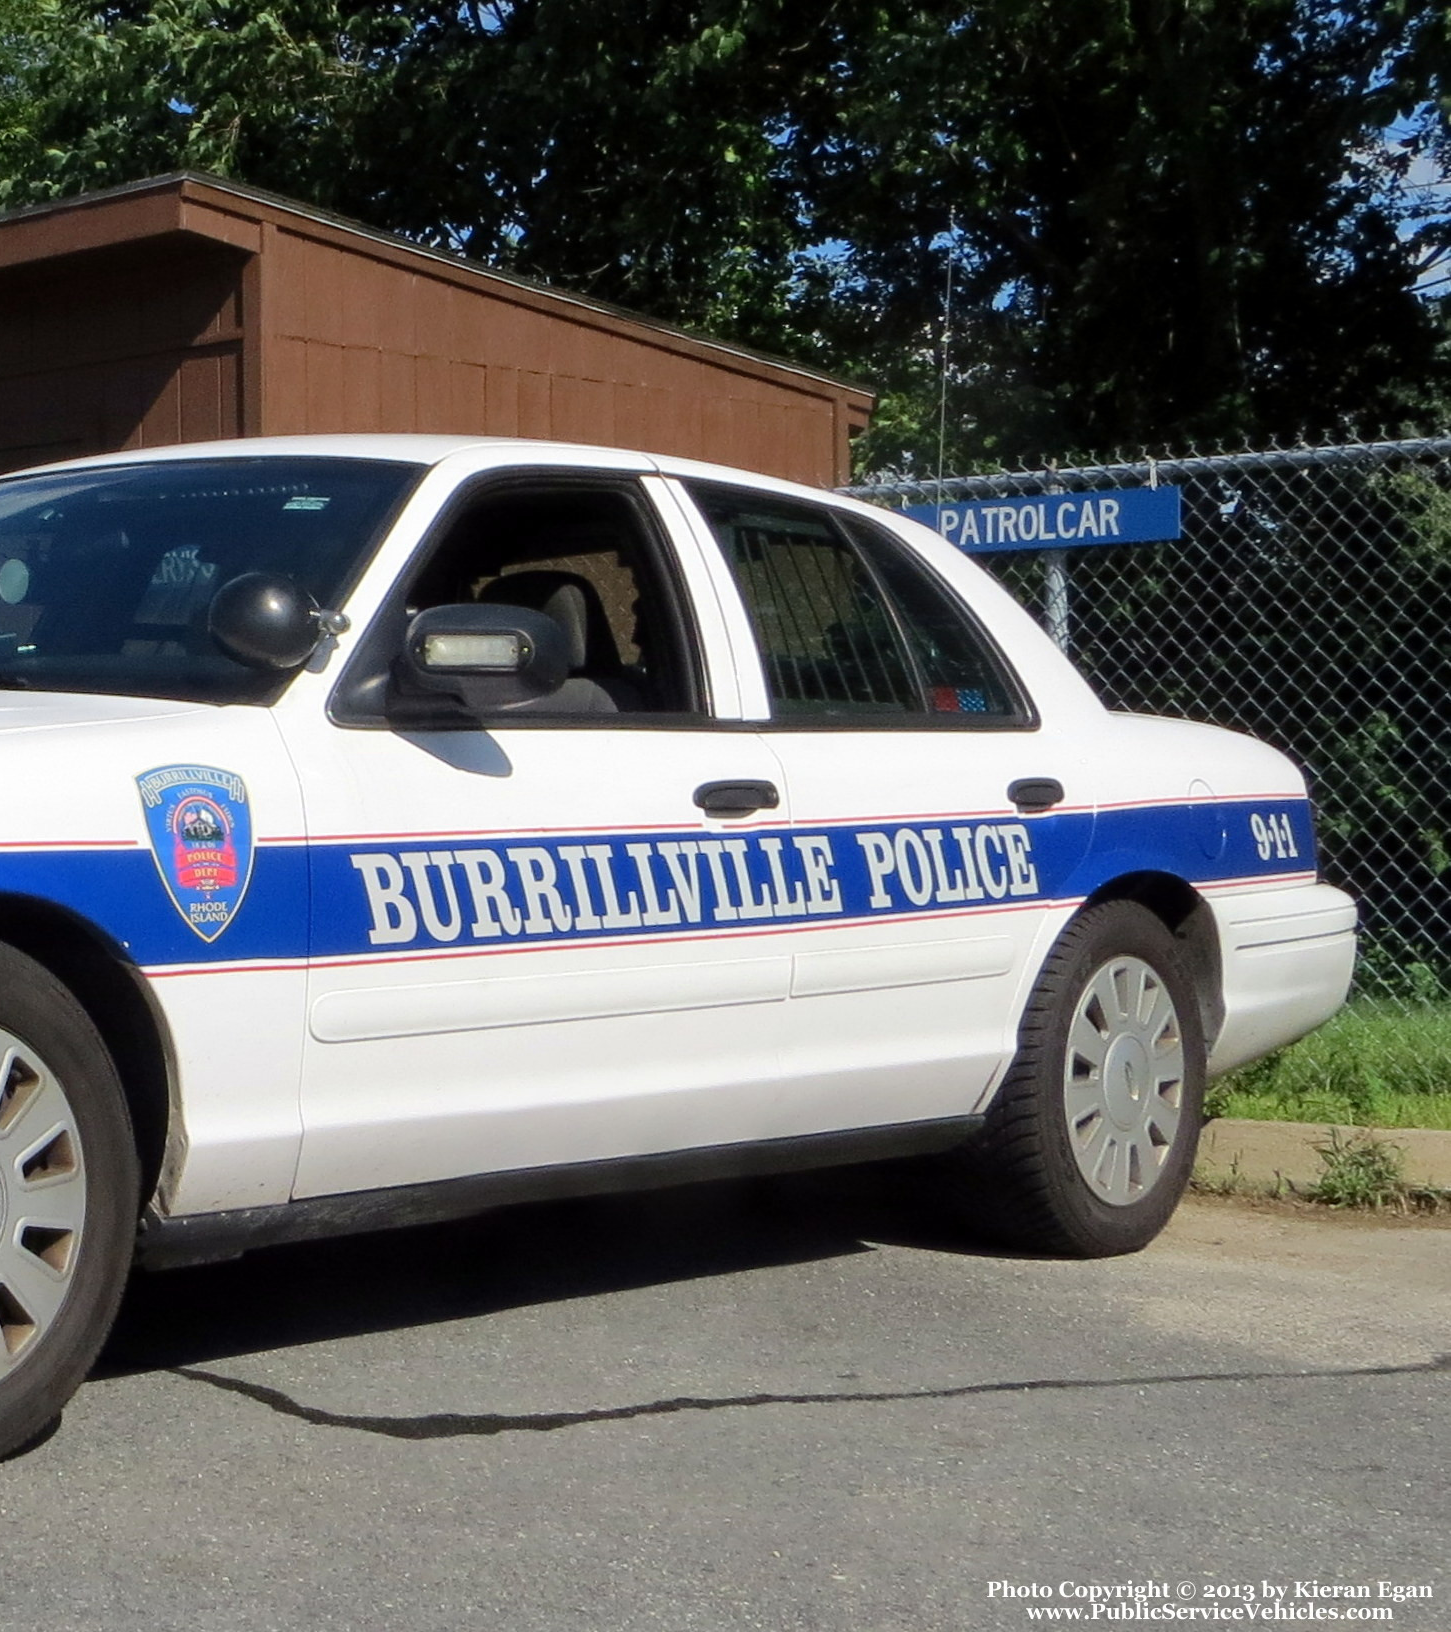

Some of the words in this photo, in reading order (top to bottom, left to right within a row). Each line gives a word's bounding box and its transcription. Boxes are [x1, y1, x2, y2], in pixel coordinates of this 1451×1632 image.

[939, 498, 1120, 546] PATROLCAR
[150, 769, 233, 789] BURRILLVILLE
[187, 851, 223, 863] POLICE
[352, 835, 844, 945] BURRILLVILLE
[856, 823, 1039, 910] POLICE
[190, 901, 228, 913] RHODE
[191, 912, 229, 923] ISLAND
